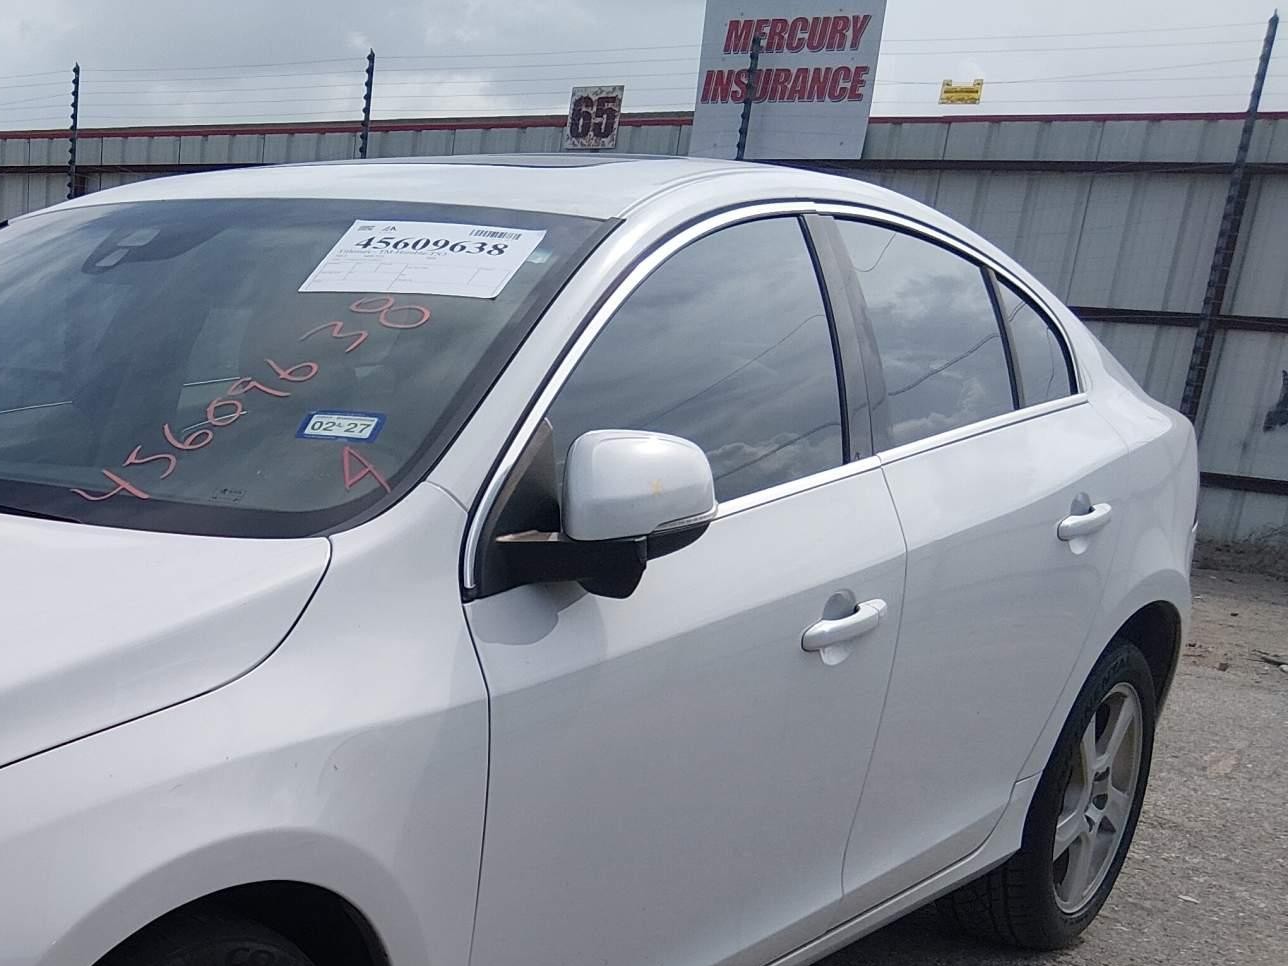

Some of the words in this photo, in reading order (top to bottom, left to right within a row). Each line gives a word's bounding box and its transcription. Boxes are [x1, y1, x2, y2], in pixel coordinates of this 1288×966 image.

[723, 14, 872, 54] MERCURY
[700, 66, 870, 104] INSURANCE
[570, 95, 617, 139] 65
[355, 235, 509, 256] 45609638
